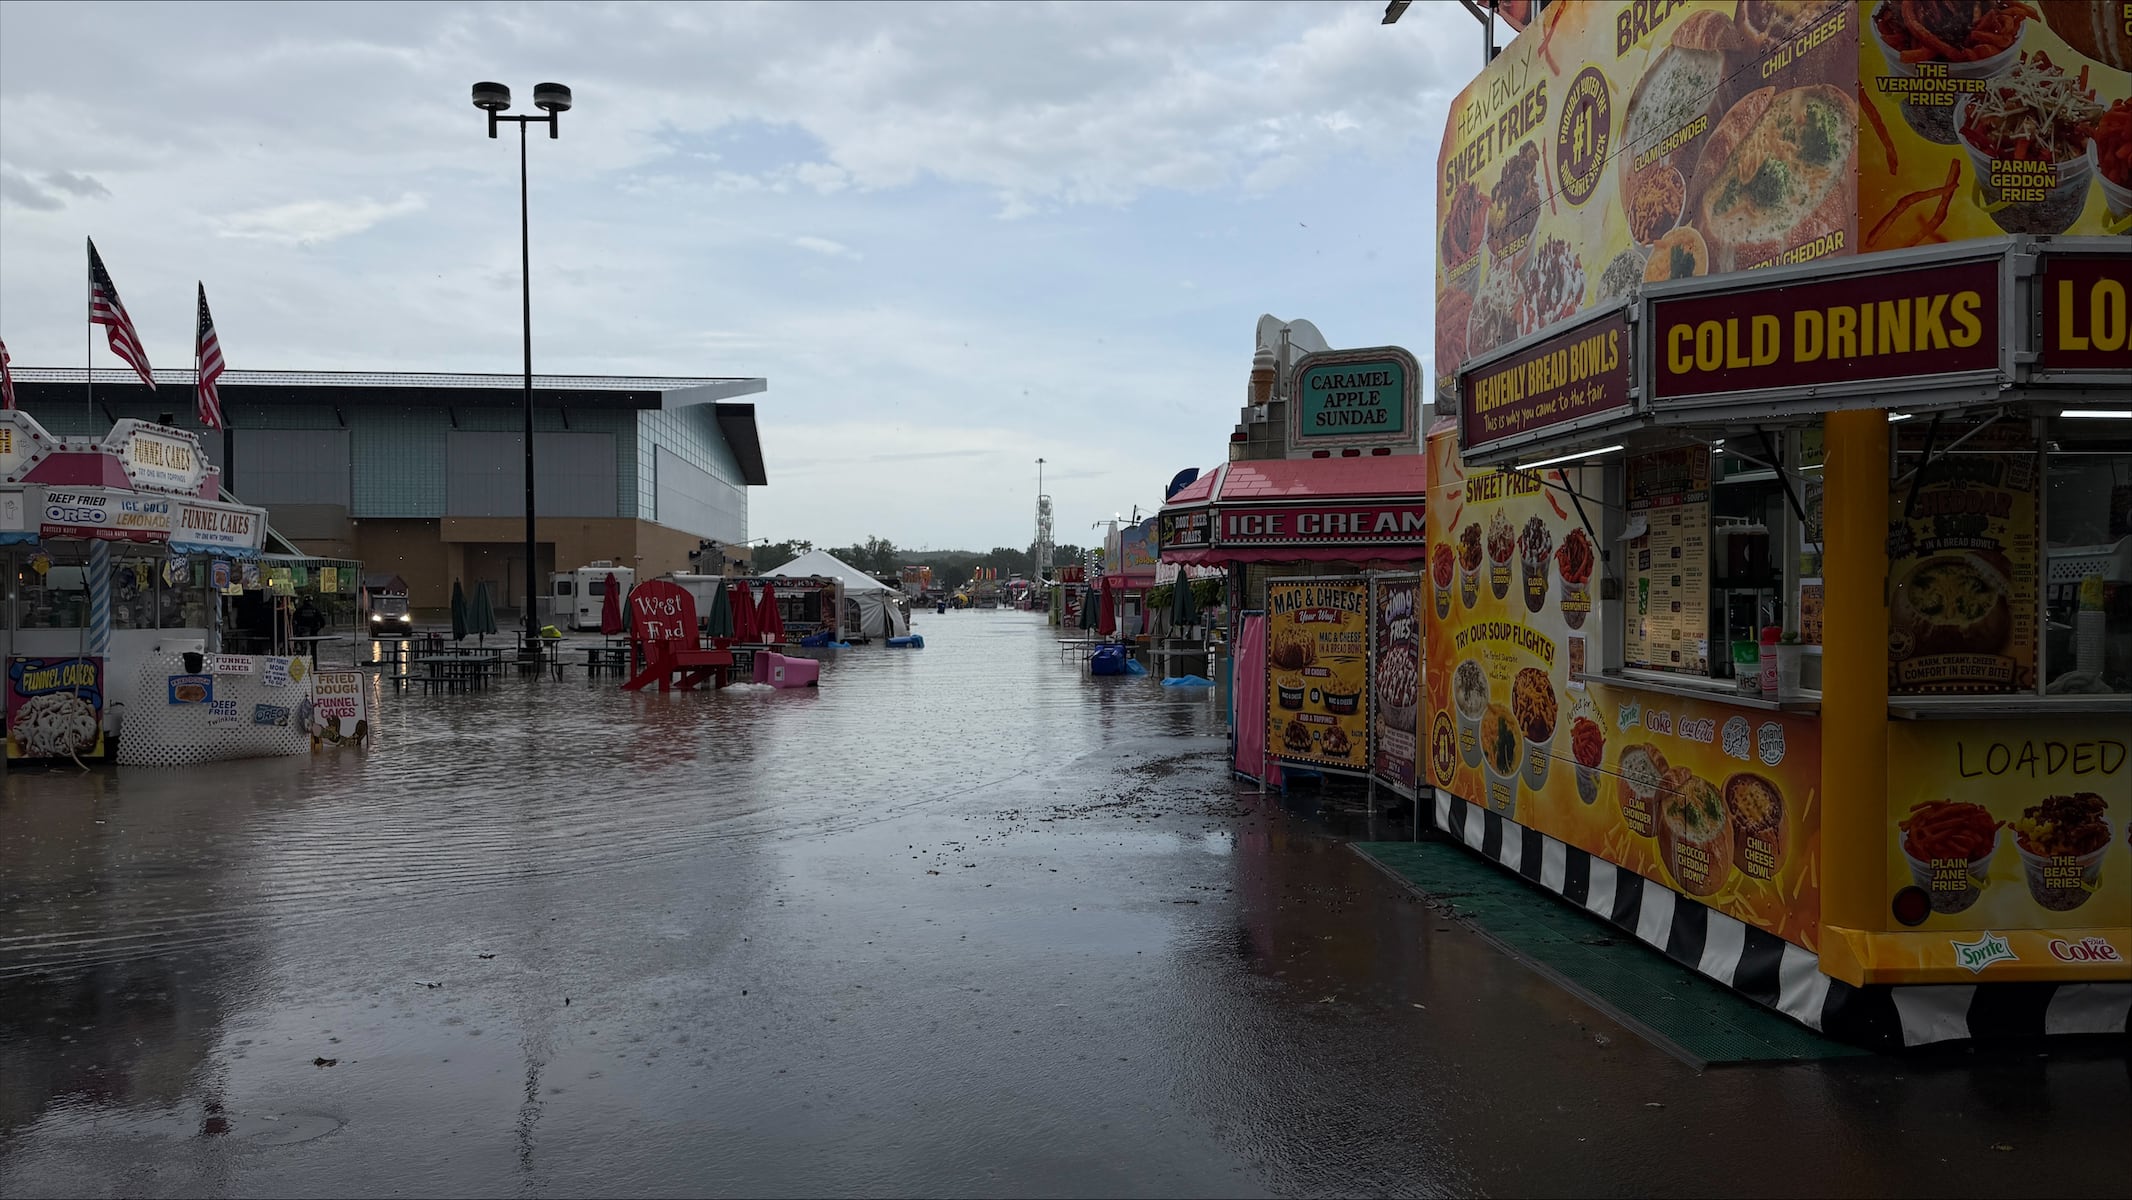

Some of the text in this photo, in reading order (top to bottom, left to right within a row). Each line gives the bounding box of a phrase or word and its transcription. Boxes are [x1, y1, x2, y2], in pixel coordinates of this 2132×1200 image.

[1761, 11, 1846, 79] CHILI CHEESE
[1917, 64, 1948, 77] THE
[1457, 44, 1532, 143] HEAVENLY
[1877, 78, 1986, 93] VERMONSTER
[1909, 92, 1954, 106] FRIES
[1560, 76, 1607, 144] PROUDLY VOTED THE
[1445, 79, 1548, 197] SWEET FRIES
[1573, 105, 1592, 166] #1
[1633, 114, 1708, 173] CLAM CHOWDER
[1991, 159, 2056, 173] PARMA-
[1990, 174, 2056, 188] GEDDON
[2001, 188, 2046, 202] FRIES
[1783, 230, 1845, 266] CHEDDAR
[2058, 278, 2132, 353] LO
[1666, 290, 1983, 376] COLD DRINKS
[1311, 371, 1394, 390] CARAMEL
[1474, 328, 1619, 415] HEAVENLY BREAD BOWLS
[1323, 391, 1381, 409] APPLE
[1484, 381, 1607, 433] This is why you came to the fair.
[1316, 409, 1388, 427] SUNDAE
[134, 438, 190, 472] FUNNEL CAKES
[1466, 468, 1542, 503] SWEET FRIES
[47, 493, 107, 507] DEEP FRIED
[121, 501, 168, 514] ICE COLD
[1909, 489, 2014, 521] CHEDDAR
[46, 506, 106, 523] OREO
[116, 514, 170, 528] LEMONADE
[181, 508, 250, 535] FUNNEL CAKES
[1229, 511, 1426, 536] ICE CREAM
[1925, 539, 1934, 549] IN
[1943, 537, 1968, 548] BREAD
[1528, 577, 1543, 586] CLOUD
[635, 594, 682, 616] West
[1273, 588, 1363, 615] MAC & CHEESE
[1299, 610, 1317, 624] Your
[643, 620, 685, 644] End
[1339, 631, 1361, 643] CHEESE
[1390, 618, 1412, 647] FRIES
[1455, 622, 1556, 666] TRY OUR SOUP FLIGHTS!
[215, 657, 252, 665] FUNNEL
[23, 663, 95, 692] FUNNEL CAKES
[318, 674, 355, 684] FRIED
[1904, 665, 2010, 680] COMFORT IN EVERY BITE!
[316, 684, 359, 694] DOUGH
[211, 700, 237, 708] DEEP
[317, 697, 358, 708] FUNNEL
[256, 709, 284, 720] OREO
[321, 707, 356, 719] CAKES
[1621, 707, 1638, 726] Sprite
[1646, 710, 1672, 734] Coke
[1758, 725, 1783, 741] Poland
[1759, 740, 1784, 758] Spring
[1957, 740, 2127, 779] LOADED
[1629, 798, 1645, 808] CLAM
[1623, 806, 1651, 825] CHOWDER
[1629, 820, 1647, 834] BOWL
[1677, 842, 1711, 864] BROCCOLI
[1746, 836, 1772, 853] CHILLI
[1677, 855, 1710, 876] CHEDDAR
[1744, 848, 1775, 869] CHEESE
[1930, 858, 1968, 869] PLAIN
[2051, 855, 2077, 867] THE
[1683, 868, 1704, 885] BOWL
[1747, 862, 1772, 881] BOWL
[1934, 869, 1967, 880] JANE
[2043, 867, 2084, 878] BEAST
[1931, 880, 1968, 891] FRIES
[2045, 878, 2081, 889] FRIES
[1962, 938, 2003, 966] Sprite
[2050, 940, 2120, 961] Coke
